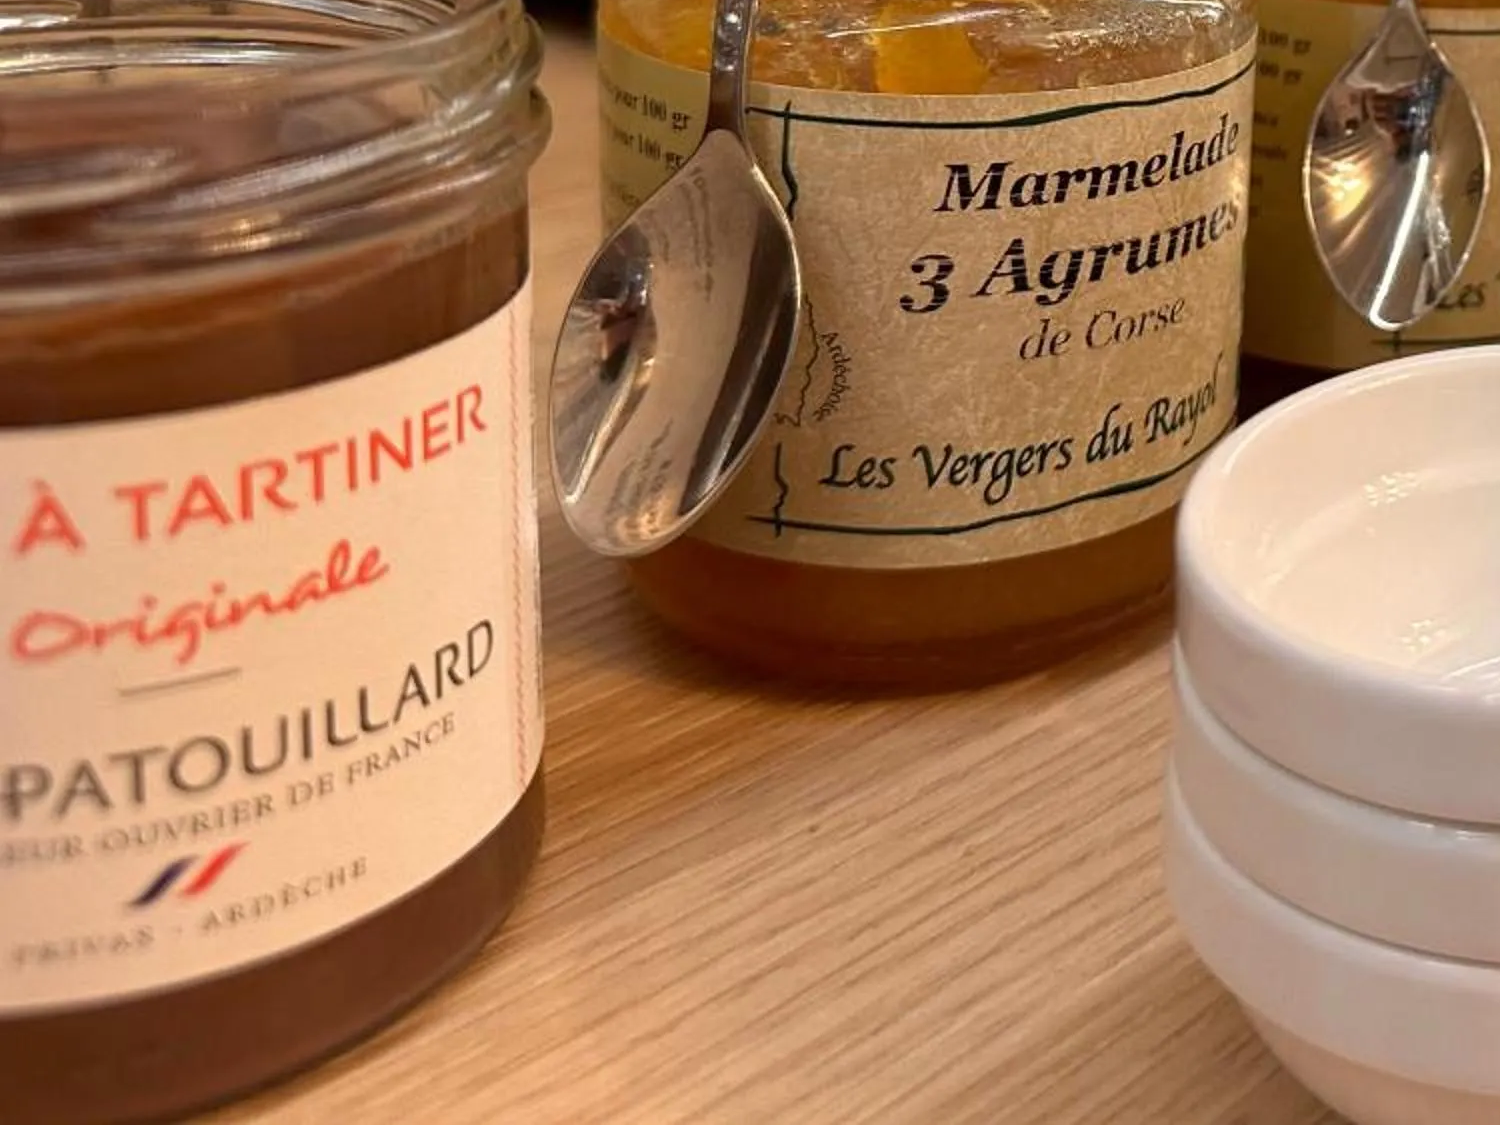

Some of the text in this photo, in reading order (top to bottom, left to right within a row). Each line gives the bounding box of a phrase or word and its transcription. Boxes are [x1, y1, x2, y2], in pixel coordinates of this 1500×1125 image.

[933, 112, 1239, 212] Marmelade
[899, 194, 1239, 314] 3 Agrumes
[1018, 295, 1186, 362] de Corse
[14, 385, 488, 560] À TARTINER
[819, 353, 1224, 506] Les Vergers du Rayol
[11, 539, 390, 665] Originale
[0, 618, 495, 824] PATOUILLARD
[101, 791, 276, 853] OUVRIER
[288, 774, 335, 808] DE
[346, 712, 457, 787] FRANCE
[201, 857, 368, 931] ARDÈCHE
